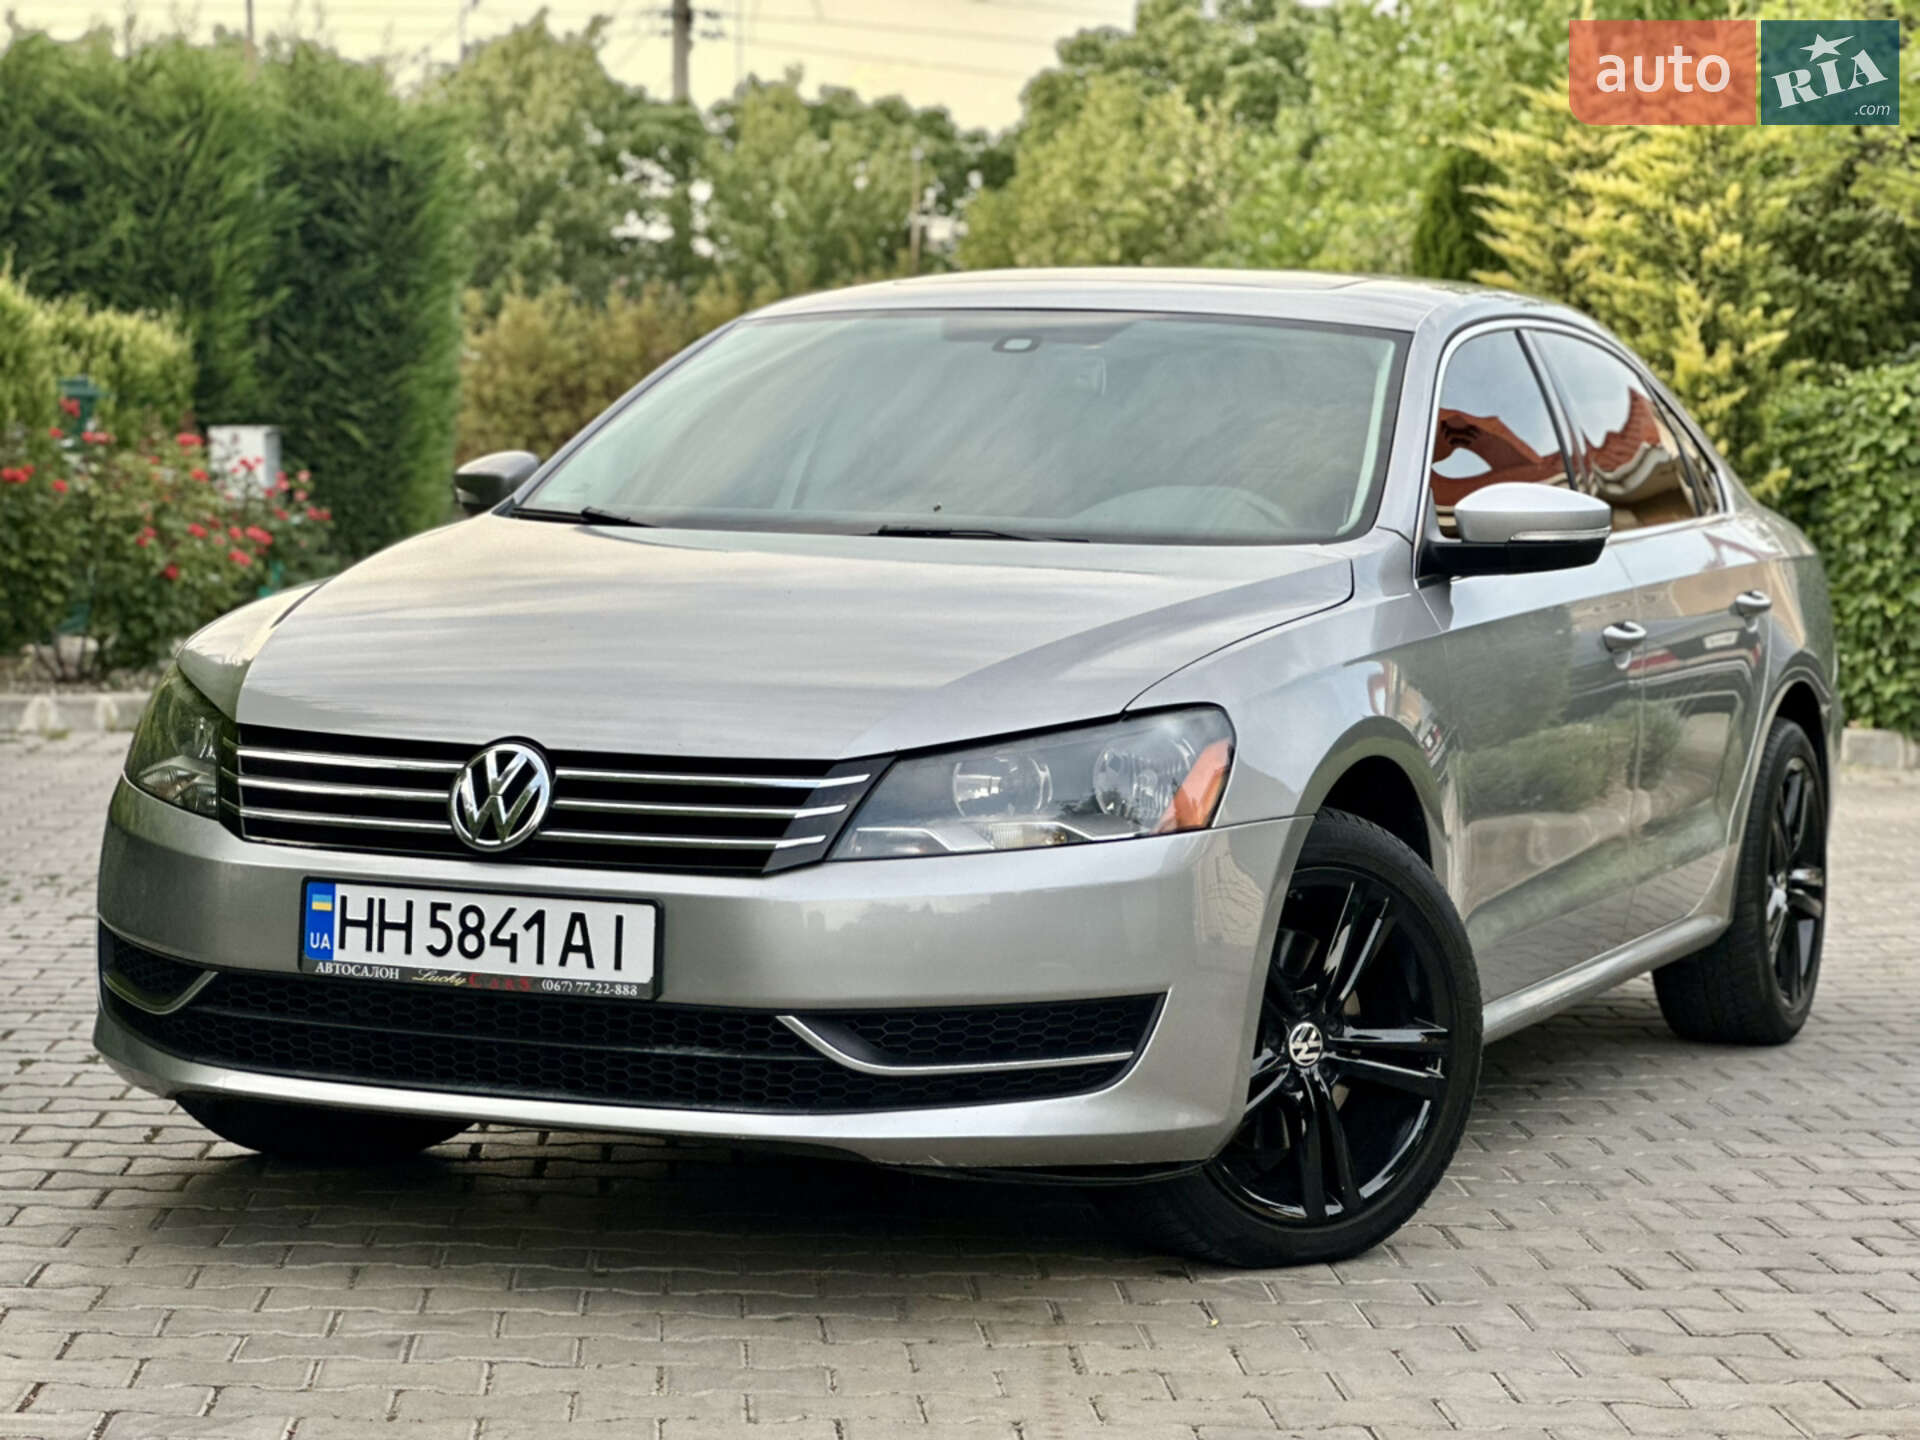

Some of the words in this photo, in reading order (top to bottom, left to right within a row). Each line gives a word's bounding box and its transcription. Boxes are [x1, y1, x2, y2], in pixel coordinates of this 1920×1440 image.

[309, 932, 332, 950] UA
[315, 961, 400, 980] АВТОСАЛОН
[541, 980, 573, 993] (067)
[575, 982, 638, 996] 77-22-888
